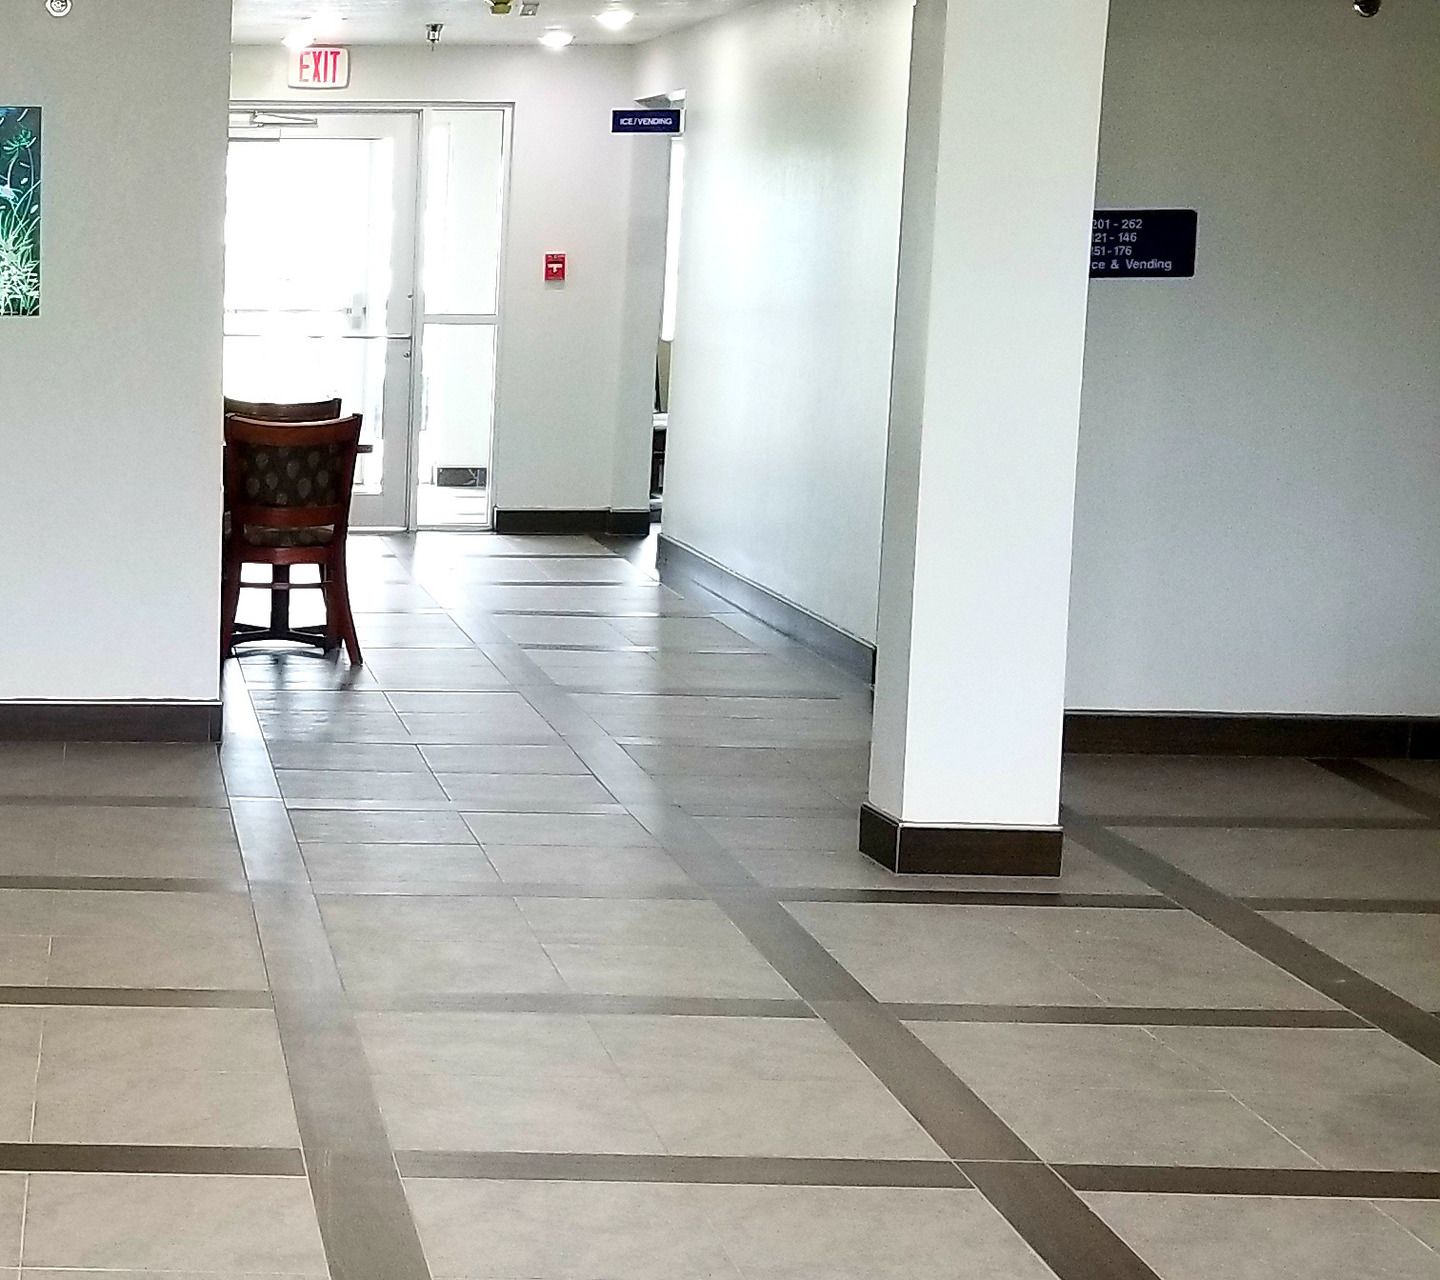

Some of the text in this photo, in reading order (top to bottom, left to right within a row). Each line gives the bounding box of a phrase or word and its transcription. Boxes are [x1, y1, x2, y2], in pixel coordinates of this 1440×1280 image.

[299, 50, 341, 83] EXIT
[1121, 218, 1143, 230] 262
[1118, 232, 1137, 243] 146
[1114, 245, 1132, 256] 176
[1091, 258, 1172, 272] ce & Vending
